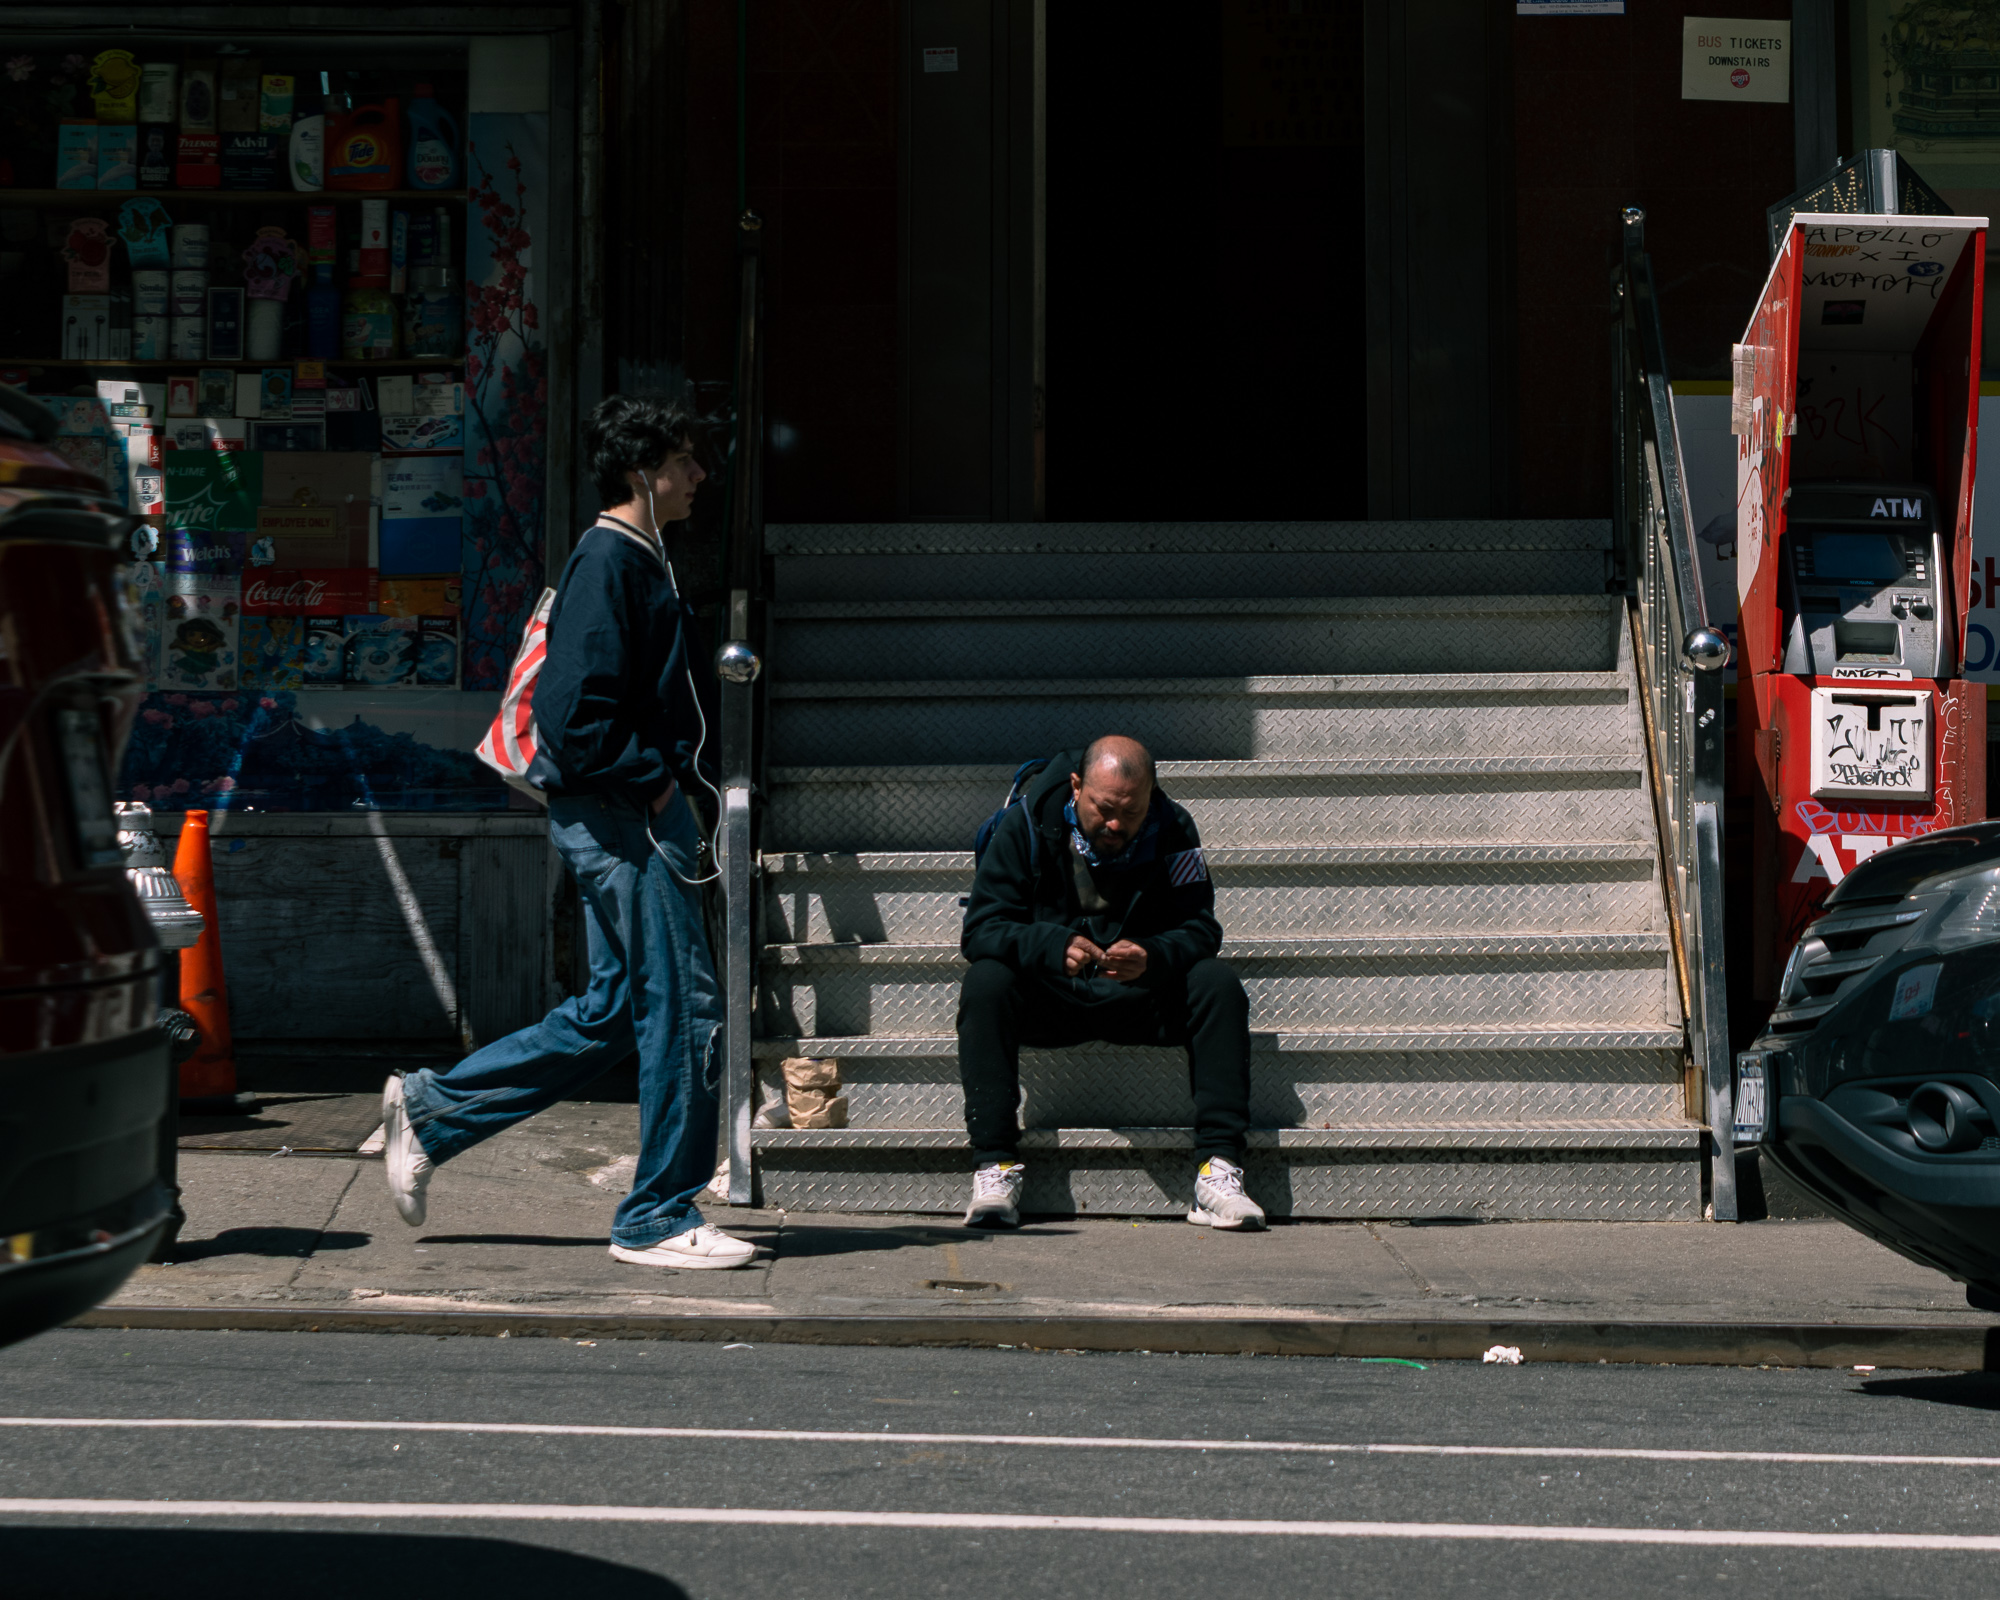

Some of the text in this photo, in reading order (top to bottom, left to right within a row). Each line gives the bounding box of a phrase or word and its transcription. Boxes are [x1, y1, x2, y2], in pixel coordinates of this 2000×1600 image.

[1698, 35, 1782, 50] BUS TICKETS
[1708, 56, 1770, 67] DOWNSTAIRS
[179, 138, 219, 149] TYLENOL
[231, 136, 268, 148] Advil
[349, 143, 375, 162] Tide
[417, 153, 449, 165] Downy
[393, 417, 421, 425] POLICE
[217, 440, 236, 450] Bee
[1870, 497, 1922, 519] ATM
[262, 516, 332, 529] EMPLOYEE ONLY
[182, 544, 231, 562] Welch's
[245, 579, 329, 607] Coca-Cola
